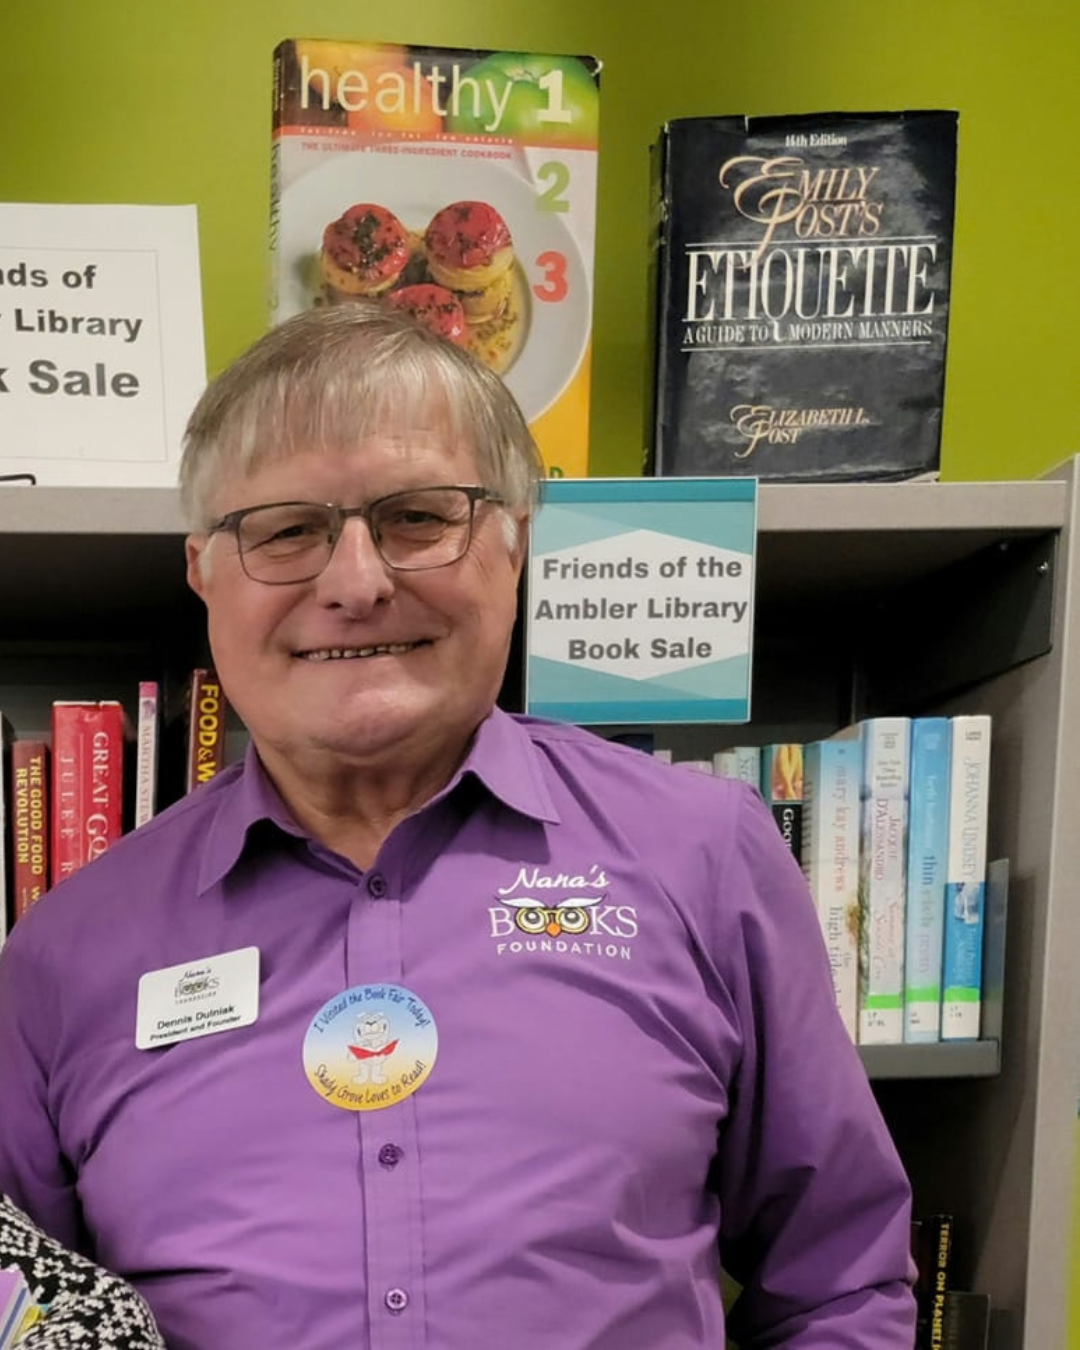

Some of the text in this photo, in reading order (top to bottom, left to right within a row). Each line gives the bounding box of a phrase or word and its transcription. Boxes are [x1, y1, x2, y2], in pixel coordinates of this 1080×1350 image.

[300, 55, 573, 132] healthy 1
[322, 142, 513, 160] ULTIMATE COOKBOOK
[808, 132, 848, 147] Edition
[536, 160, 571, 213] 2
[62, 265, 98, 290] of
[532, 250, 569, 304] 3
[682, 244, 938, 335] ETIQUETTE
[14, 308, 143, 343] Library
[683, 319, 933, 344] A GUIDE TO MODERN MANNERS
[29, 360, 140, 398] Sale
[542, 556, 742, 579] Friends of the
[534, 597, 748, 624] Ambler Library
[568, 637, 713, 660] Book Sale
[199, 684, 219, 747] FOOD
[92, 732, 109, 809] GREAT
[16, 768, 29, 863] REVOLUTION
[30, 756, 43, 875] THE GOOD FOOD
[498, 864, 610, 895] Nana's
[922, 856, 939, 885] thin
[488, 904, 638, 938] BOOKS
[497, 940, 632, 960] FOUNDATION
[150, 1015, 241, 1041] President and Founder
[157, 1005, 235, 1030] Dennis Dulniak
[336, 1085, 390, 1104] Grove Loves
[932, 1223, 949, 1345] TERROR ON PLANET
